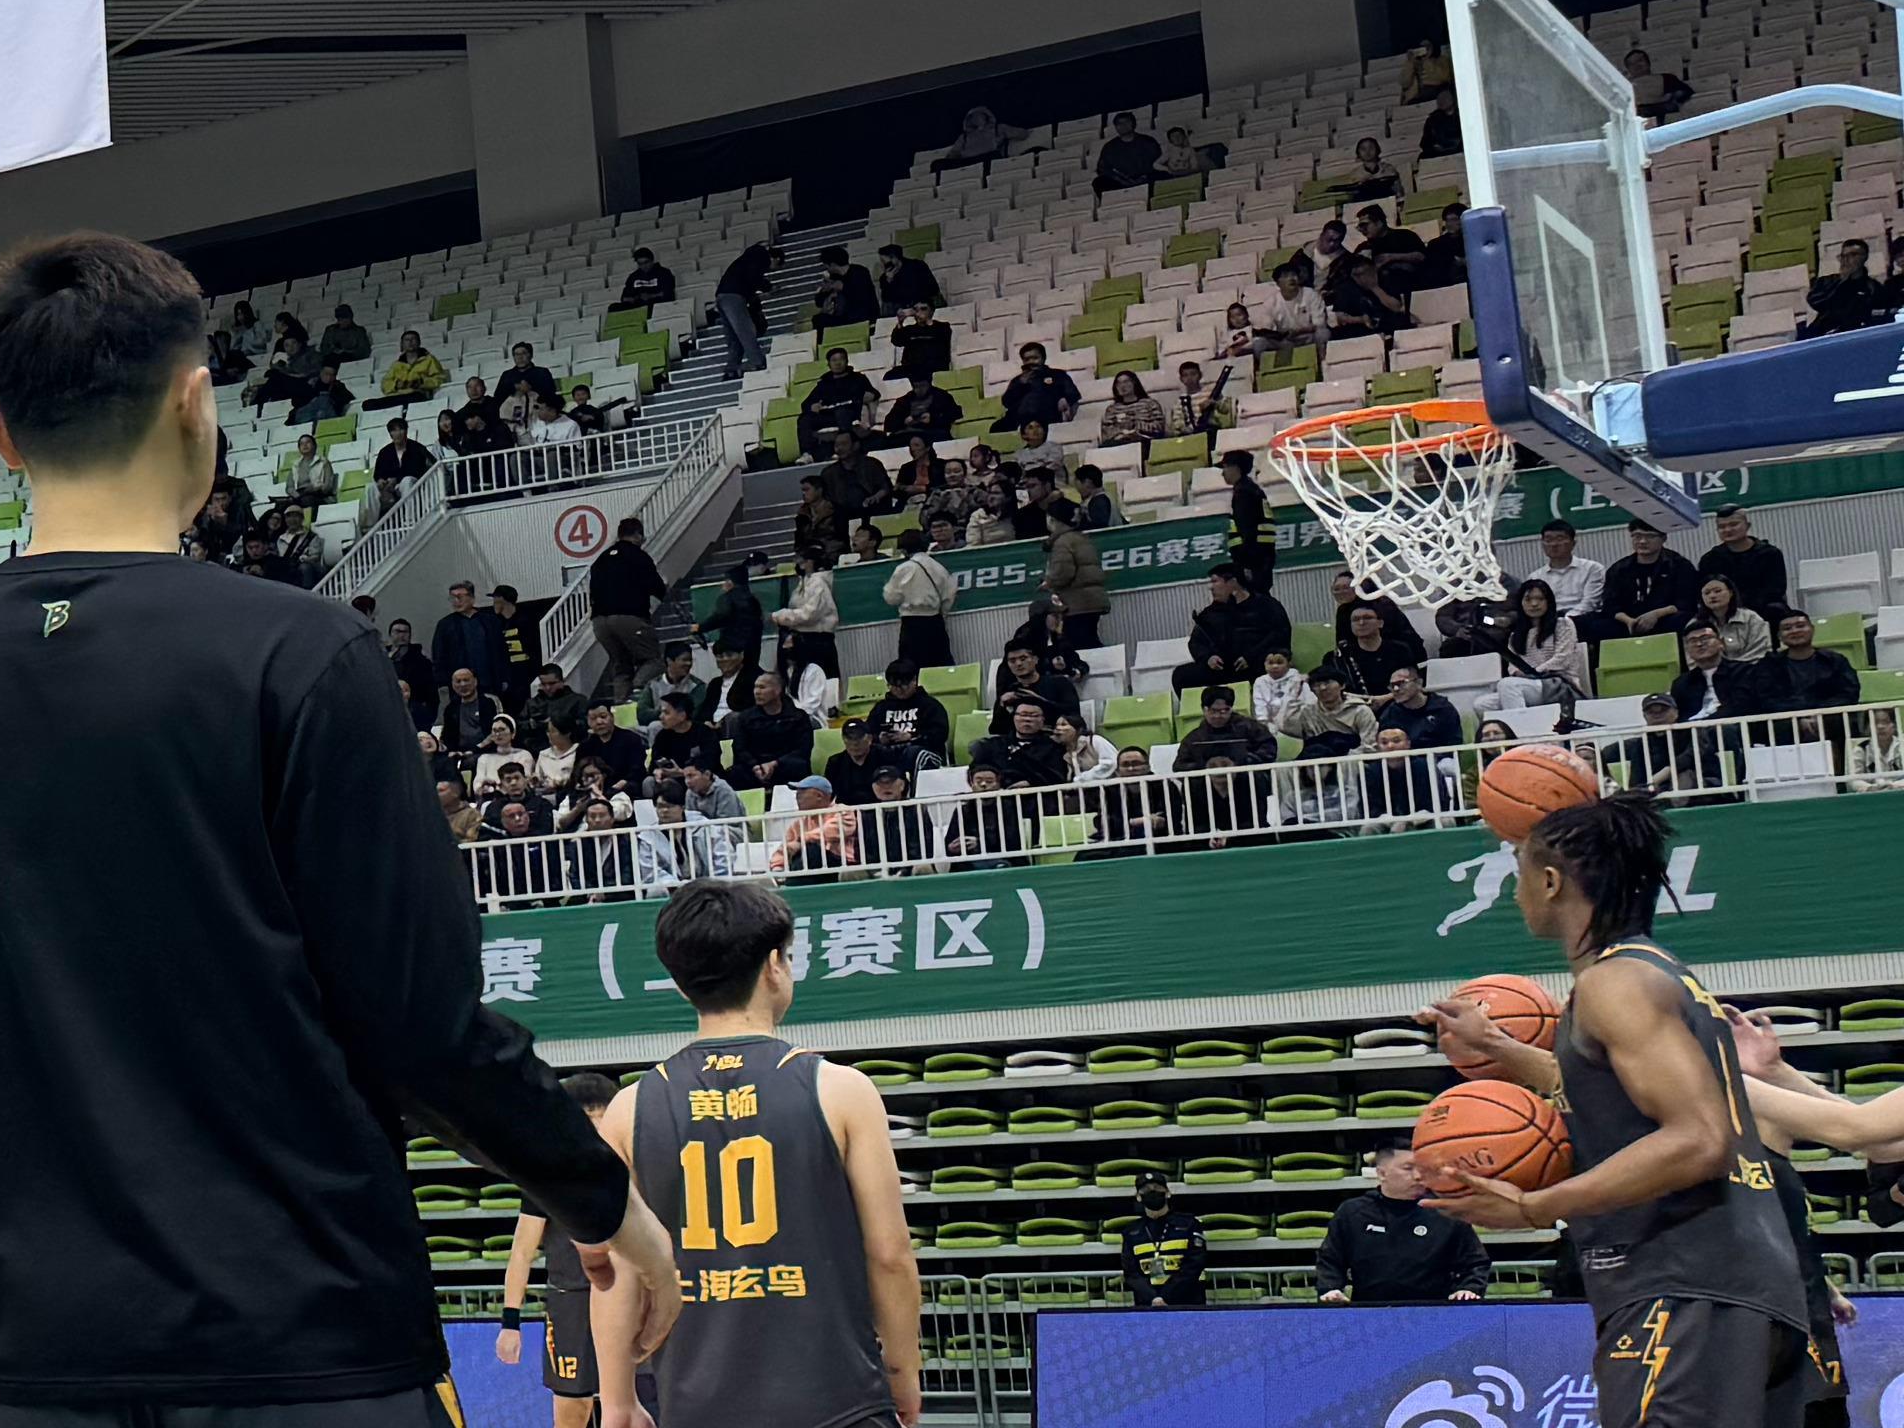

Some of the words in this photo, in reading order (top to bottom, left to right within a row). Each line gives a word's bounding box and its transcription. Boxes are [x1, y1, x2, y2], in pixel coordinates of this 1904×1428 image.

[565, 515, 598, 547] 4
[679, 1134, 779, 1250] 10
[675, 1264, 808, 1303] 上海玄鸟
[558, 1355, 578, 1380] 12
